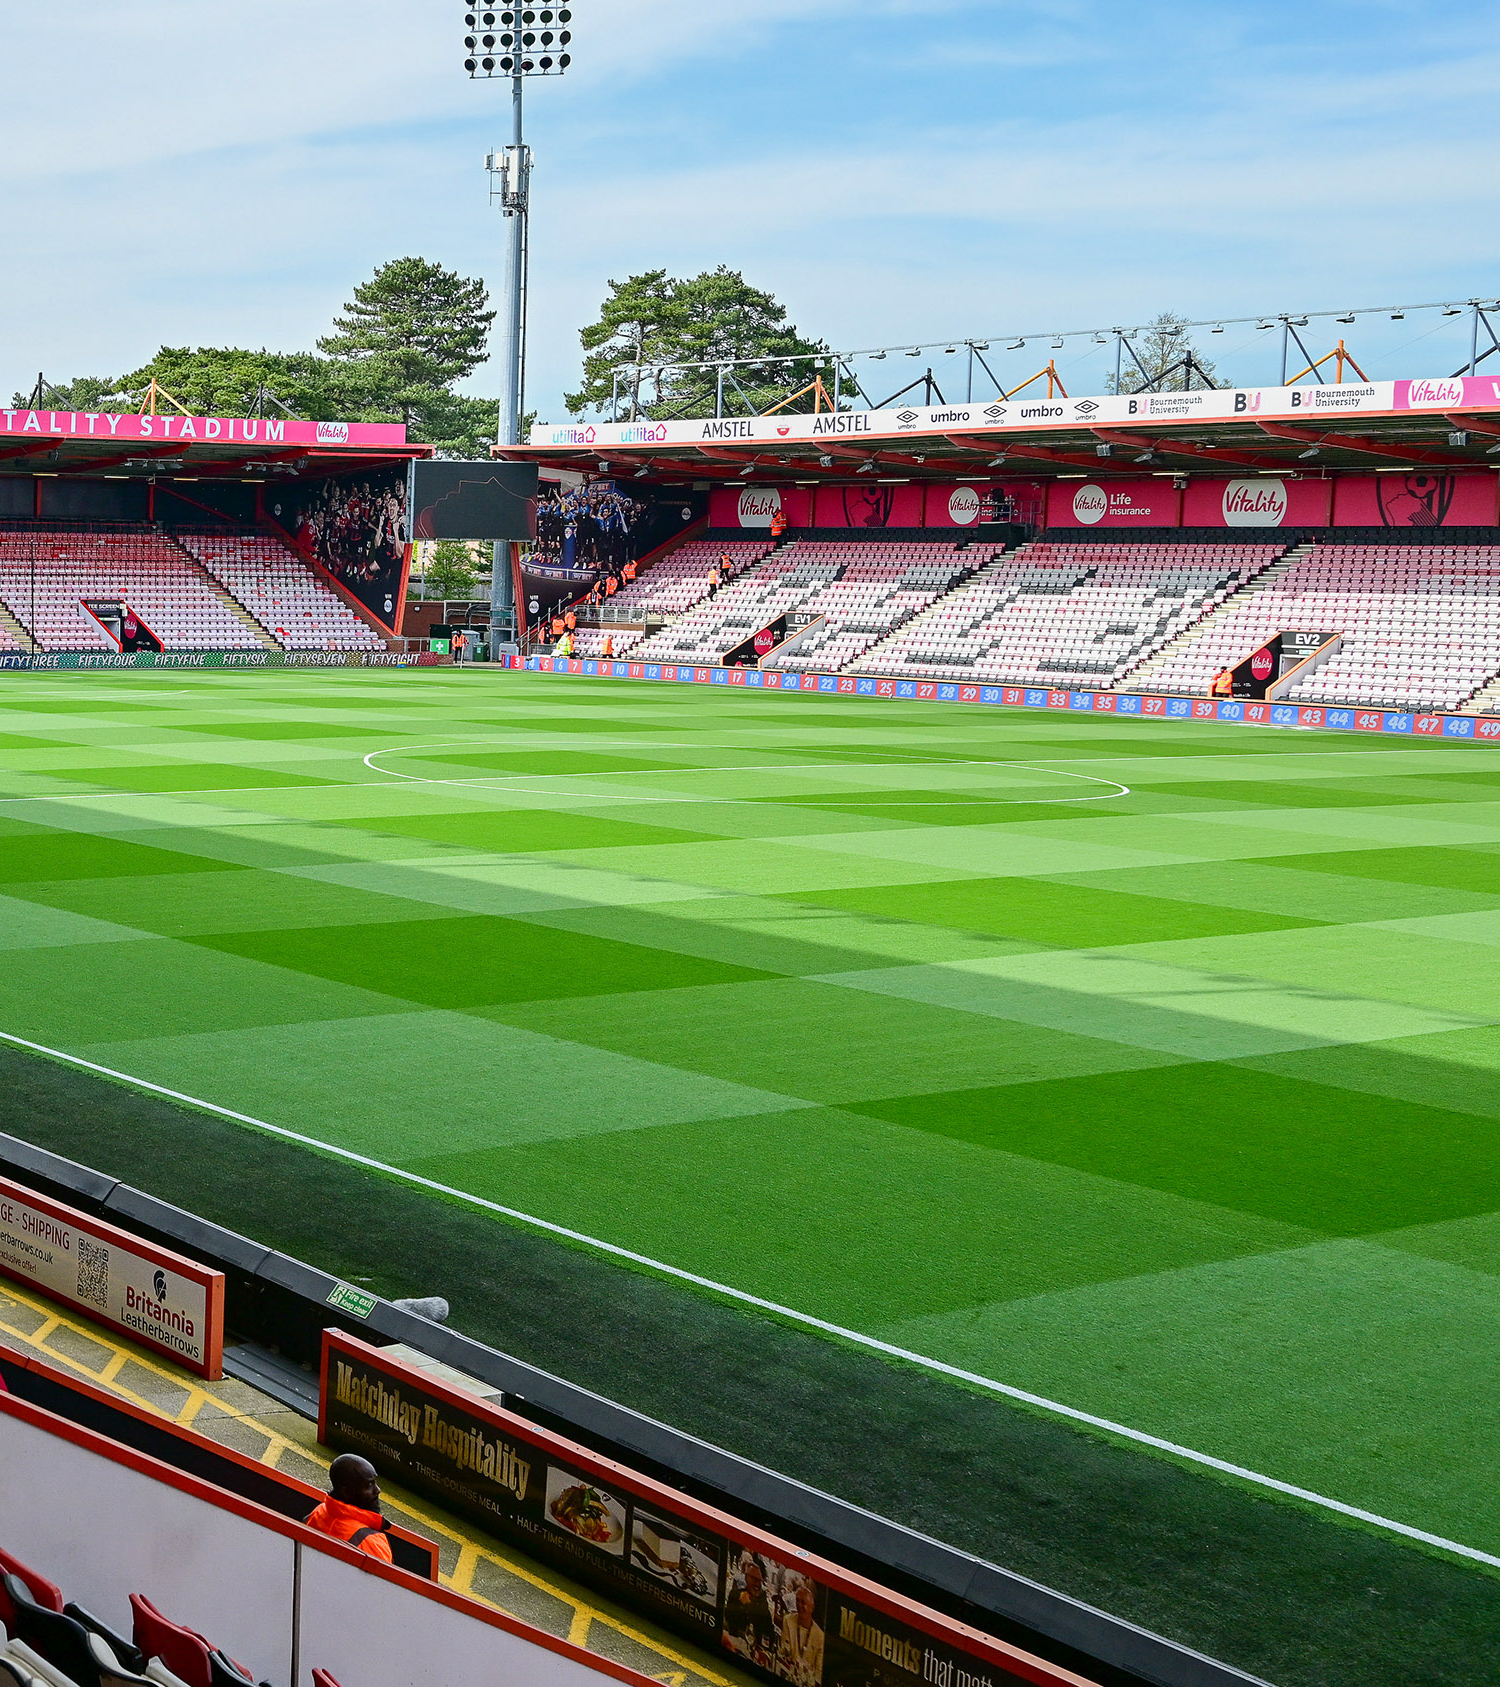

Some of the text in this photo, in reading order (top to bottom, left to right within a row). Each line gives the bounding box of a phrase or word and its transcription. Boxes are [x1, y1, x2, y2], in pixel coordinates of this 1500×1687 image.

[1150, 395, 1203, 407] Bournemouth
[1291, 391, 1313, 408] BU
[1315, 387, 1376, 399] Bournemouth
[1411, 380, 1463, 406] Vitality
[1128, 399, 1148, 415] BU
[1150, 404, 1191, 415] University
[1234, 391, 1262, 413] BU
[1315, 397, 1361, 409] University
[930, 410, 970, 424] umbro
[1020, 405, 1063, 419] umbro
[1075, 413, 1097, 421] umbro
[139, 415, 284, 441] STADIUM
[702, 421, 754, 438] AMSTEL
[813, 414, 871, 435] AMSTEL
[984, 418, 1005, 426] umbro
[318, 423, 348, 442] Vitality
[552, 430, 585, 444] utilita
[620, 427, 655, 442] utilita
[739, 493, 781, 517] Vitality
[950, 492, 980, 515] Vitality
[1074, 494, 1106, 515] Vitality
[1110, 494, 1131, 505] Life
[1226, 485, 1285, 521] Vitality
[1109, 506, 1151, 515] insurance
[794, 614, 811, 624] EV1
[1295, 633, 1320, 645] EV2
[79, 655, 136, 666] FIFTYFOUR
[154, 655, 206, 666] FIFTYFIVE
[222, 655, 267, 665] FIFTYSIX
[283, 654, 347, 665] FIFTYSEVEN
[362, 654, 420, 665] FIFTYEIGHT
[1251, 656, 1273, 672] Vitality
[587, 663, 1500, 736] 8 9 10 11 12 13 14 15 16 17 18 19 20 21 22 23 24 25 26 27 28 29 30 31 32 33 34 35 36 37 38 39 40 41 42 43 44 45 46 47 48 49
[21, 1213, 71, 1250] SHIPPING
[340, 1298, 368, 1315] Keep clear
[345, 1290, 374, 1309] Fire exit
[126, 1285, 195, 1338] Britannia
[120, 1307, 199, 1359] Leatherbarrows
[336, 1360, 532, 1501] Matchday Hospitality
[340, 1421, 401, 1462] WELCOME DRINK
[416, 1461, 502, 1516] THREE-COURSE MEAL
[516, 1514, 716, 1628] HALF-TIME AND FULL-TIME REFRESHMENTS
[839, 1606, 954, 1687] Moments that
